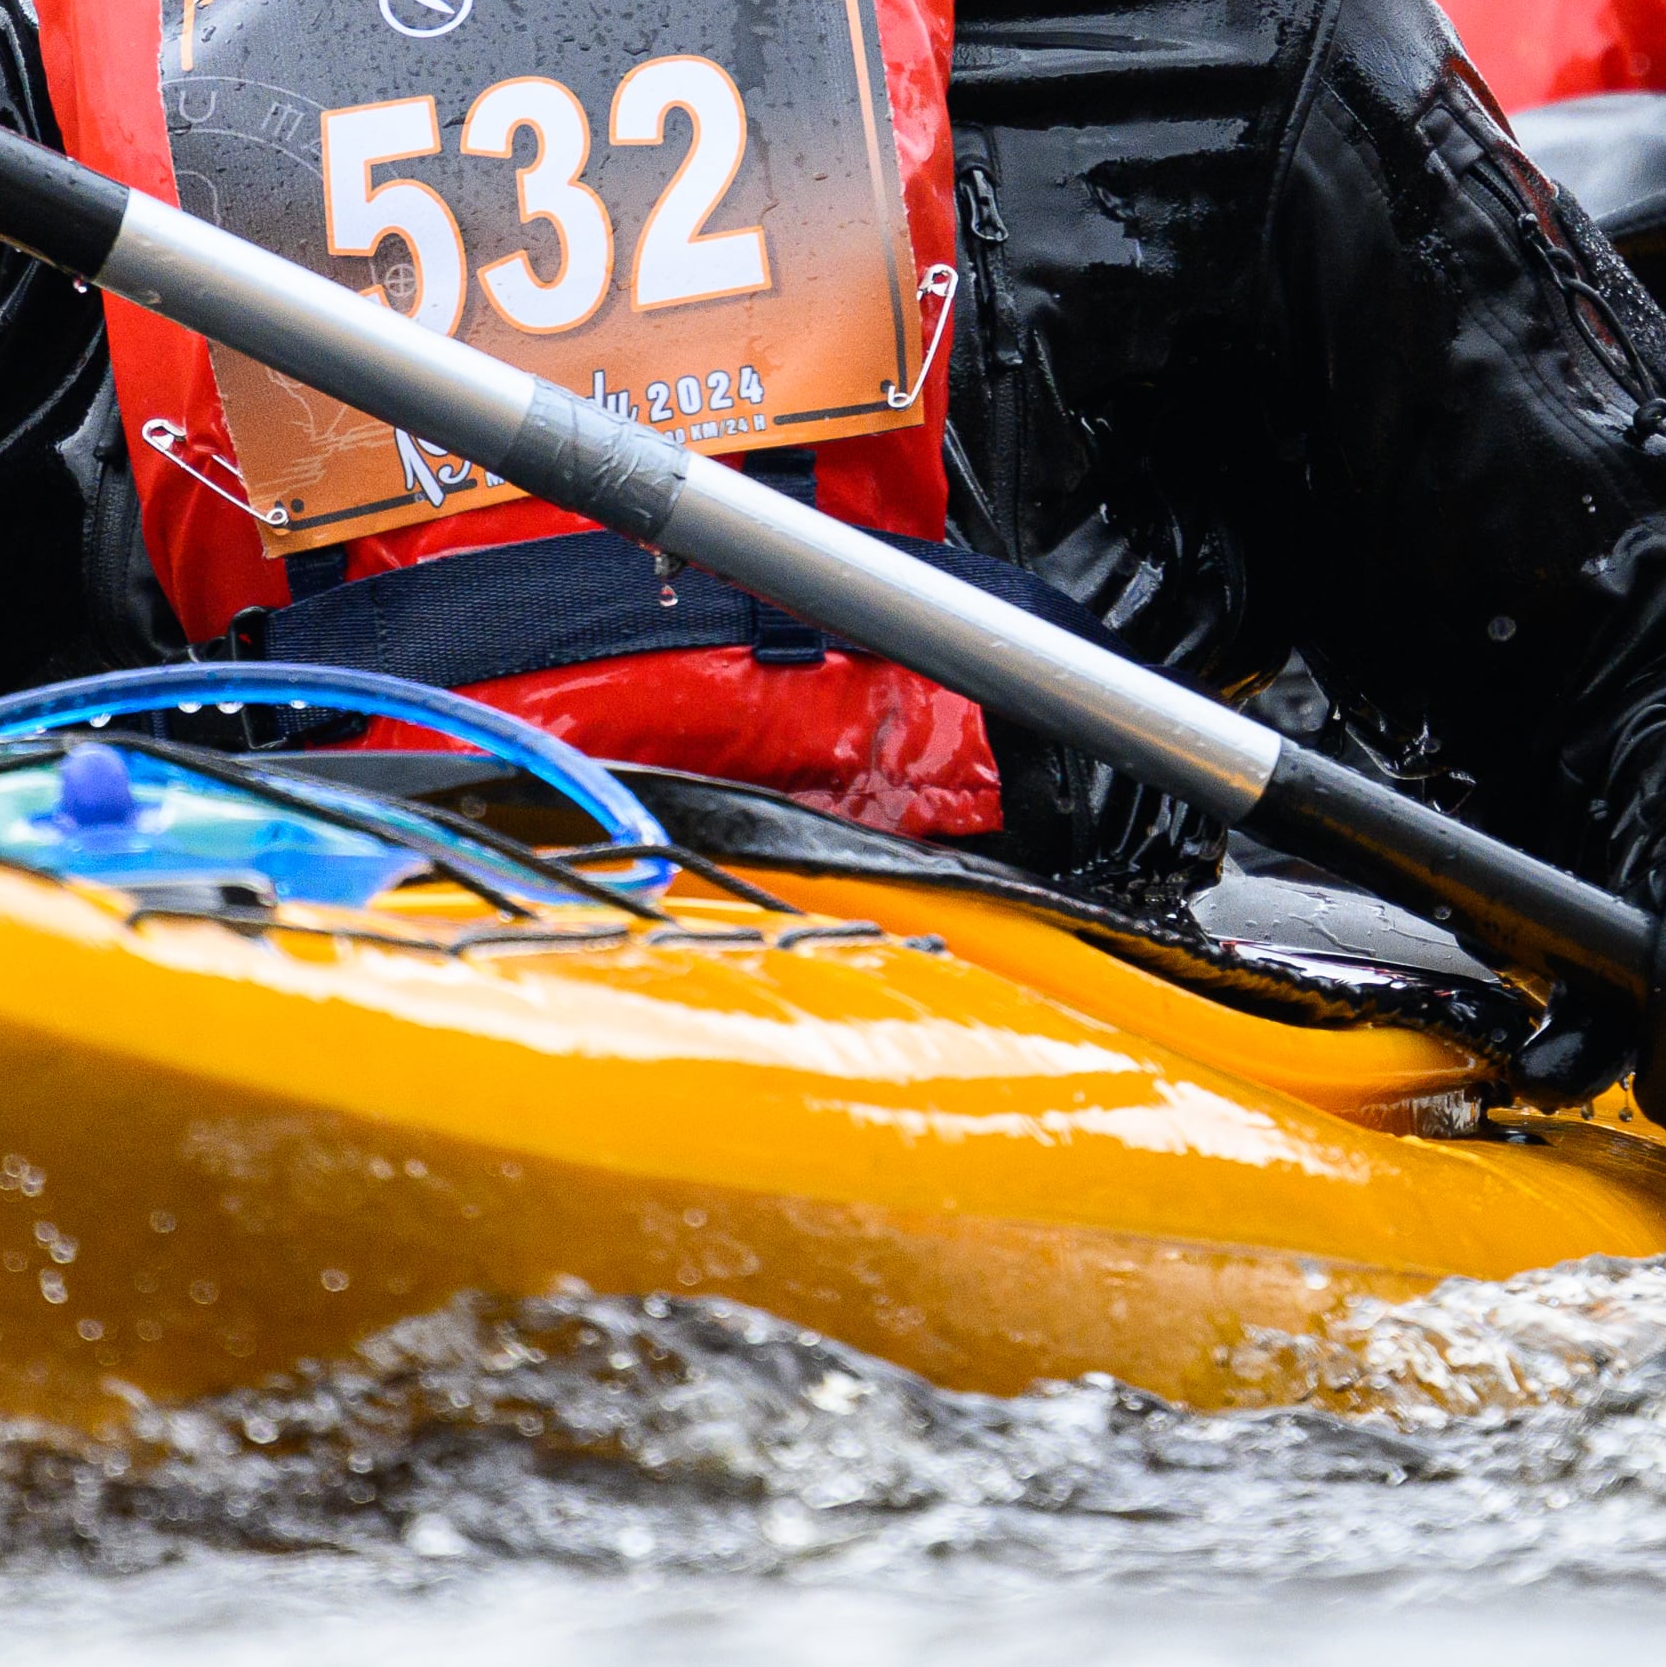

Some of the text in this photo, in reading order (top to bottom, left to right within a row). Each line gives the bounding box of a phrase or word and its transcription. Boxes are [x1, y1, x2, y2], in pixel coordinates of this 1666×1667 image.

[321, 54, 773, 338] 532
[646, 365, 765, 423] 2024
[753, 413, 767, 432] H
